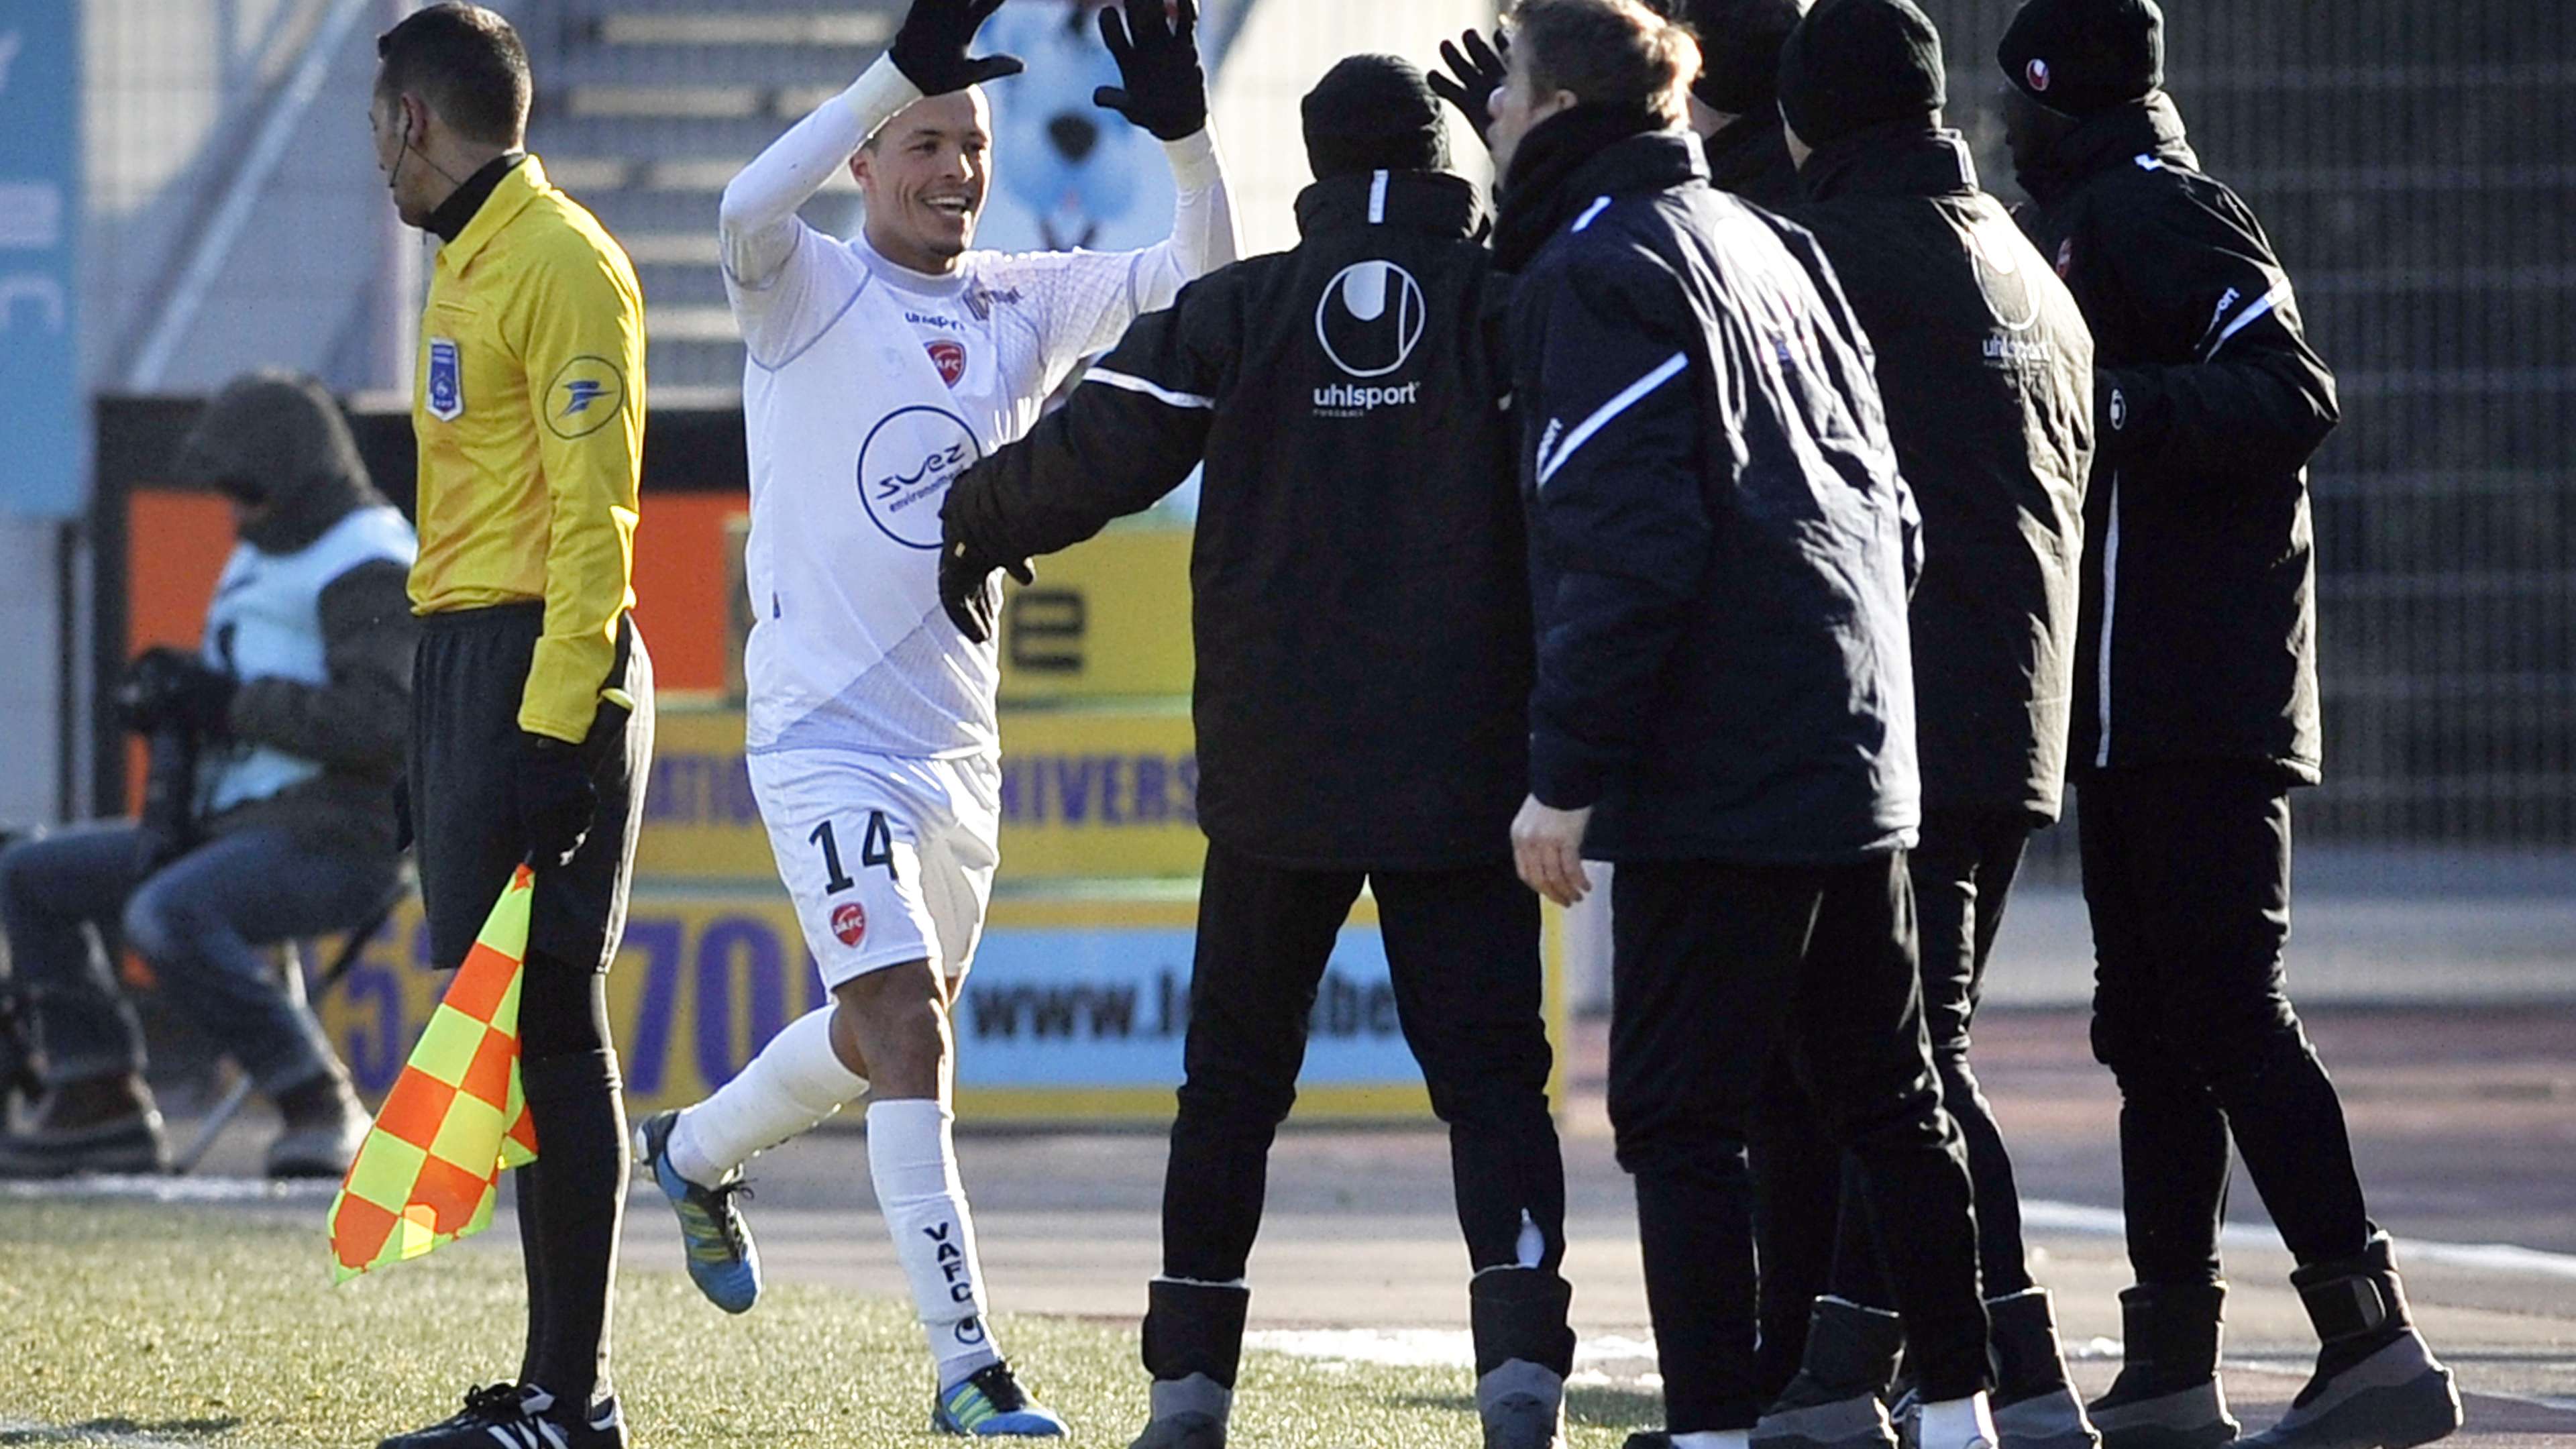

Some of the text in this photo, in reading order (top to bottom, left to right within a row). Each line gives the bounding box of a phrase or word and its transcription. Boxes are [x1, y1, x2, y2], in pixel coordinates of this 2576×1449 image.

[1313, 382, 1416, 410] uhlsport
[876, 443, 965, 500] suez
[809, 811, 899, 896] 14
[922, 1222, 973, 1303] VAFC
